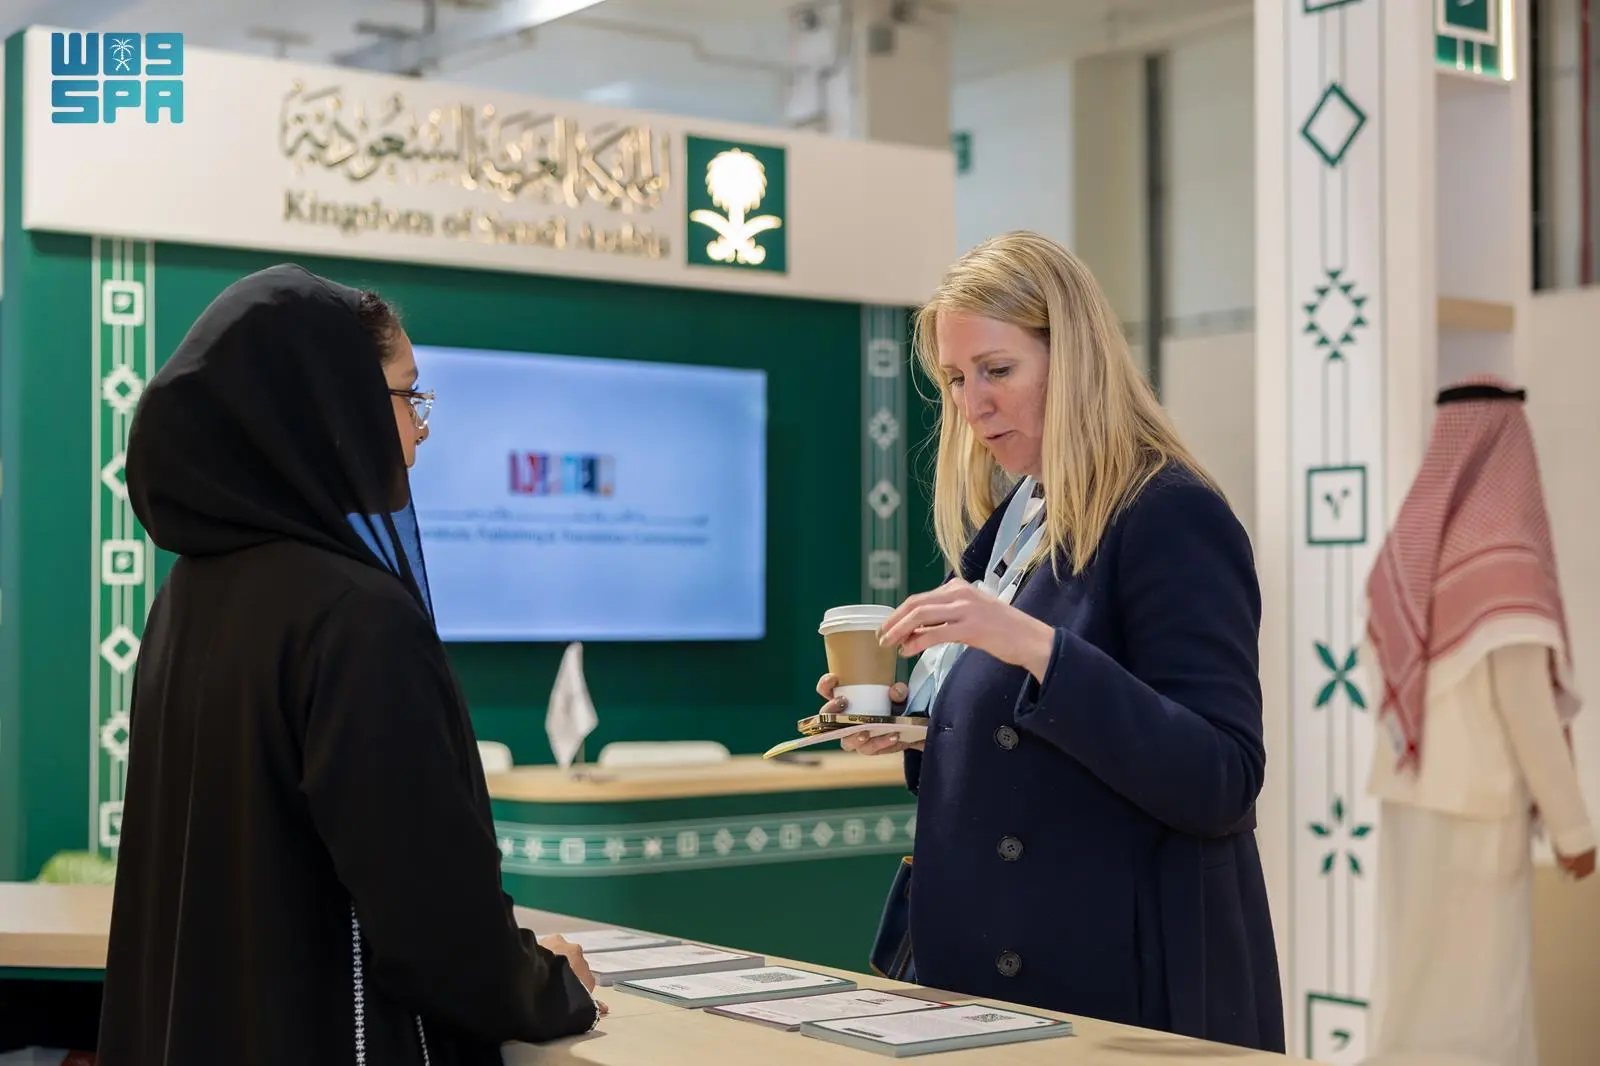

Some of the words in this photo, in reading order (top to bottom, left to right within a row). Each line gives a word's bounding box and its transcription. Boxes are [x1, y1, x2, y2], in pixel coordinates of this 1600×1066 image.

[283, 188, 434, 237] Kingdom
[442, 209, 474, 242] of
[477, 213, 568, 251] Saudi
[577, 221, 671, 260] Arabia
